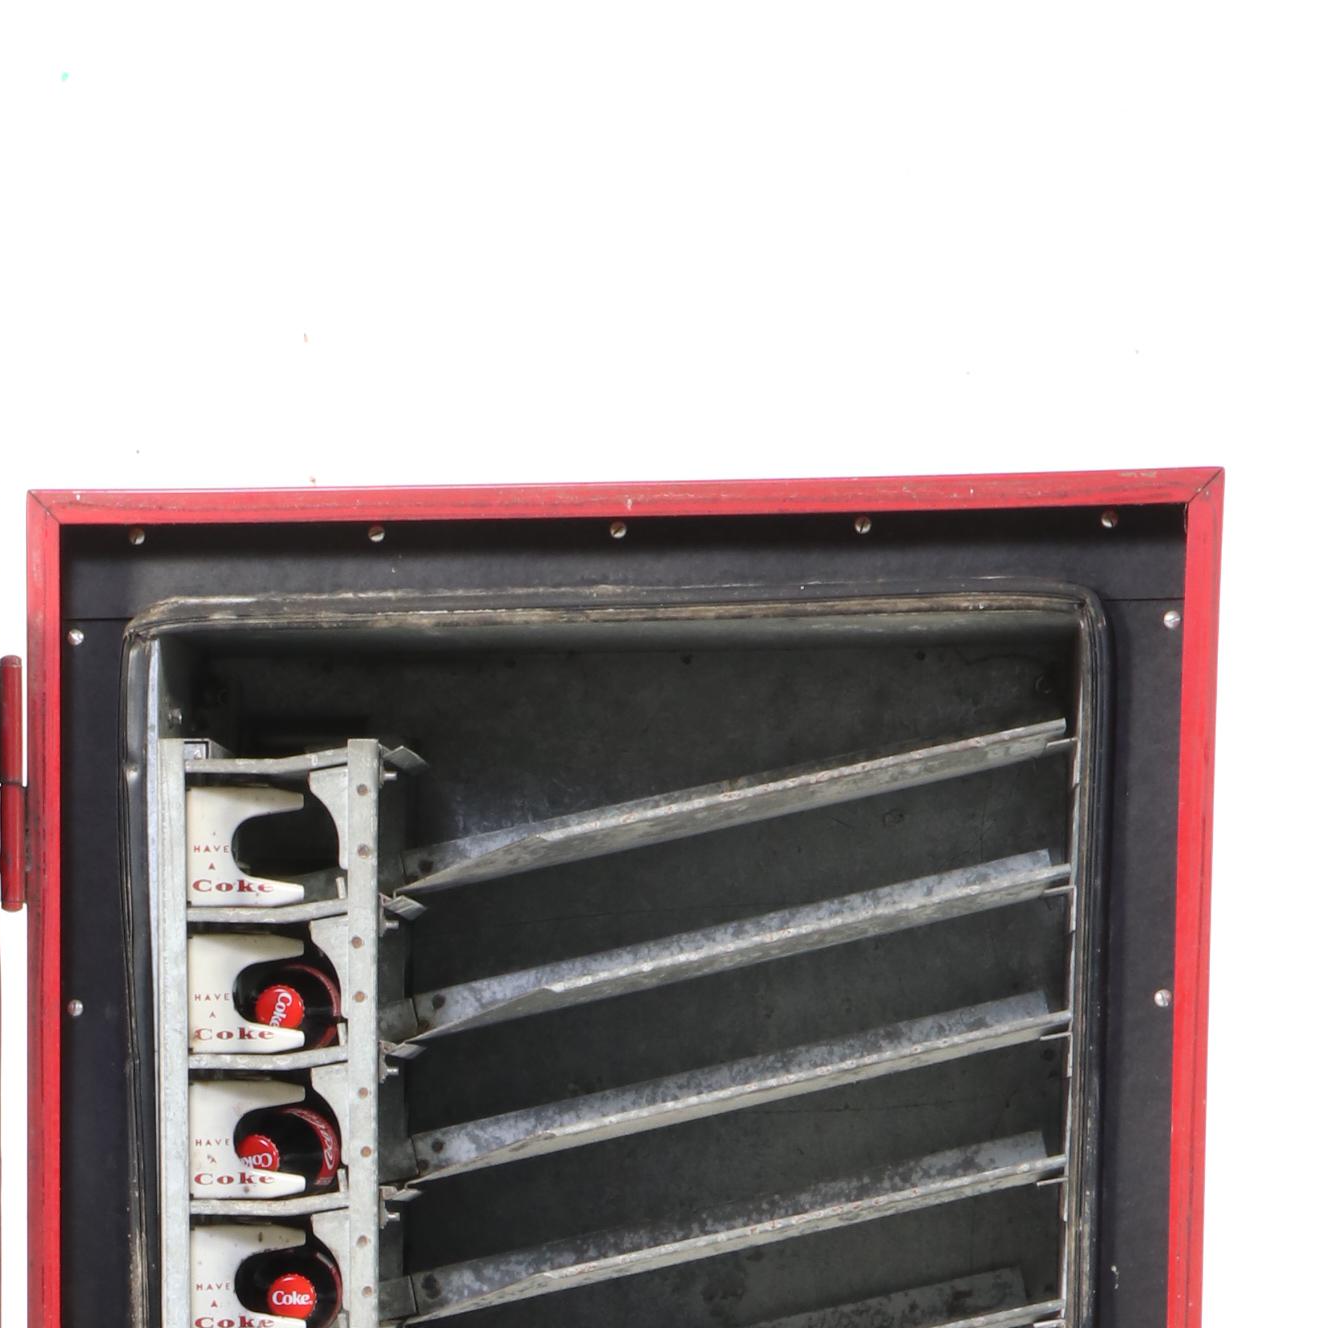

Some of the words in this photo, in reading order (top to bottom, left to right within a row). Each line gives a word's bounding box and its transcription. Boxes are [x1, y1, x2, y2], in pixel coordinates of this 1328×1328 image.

[193, 845, 230, 853] HAVE
[192, 879, 274, 892] Coke
[193, 993, 232, 1002] HAVE
[193, 1027, 275, 1041] Coke
[194, 1138, 231, 1147] HAVE
[193, 1172, 276, 1186] Coke
[195, 1282, 232, 1291] HAVE
[210, 1300, 218, 1308] A
[194, 1315, 274, 1328] Coke
